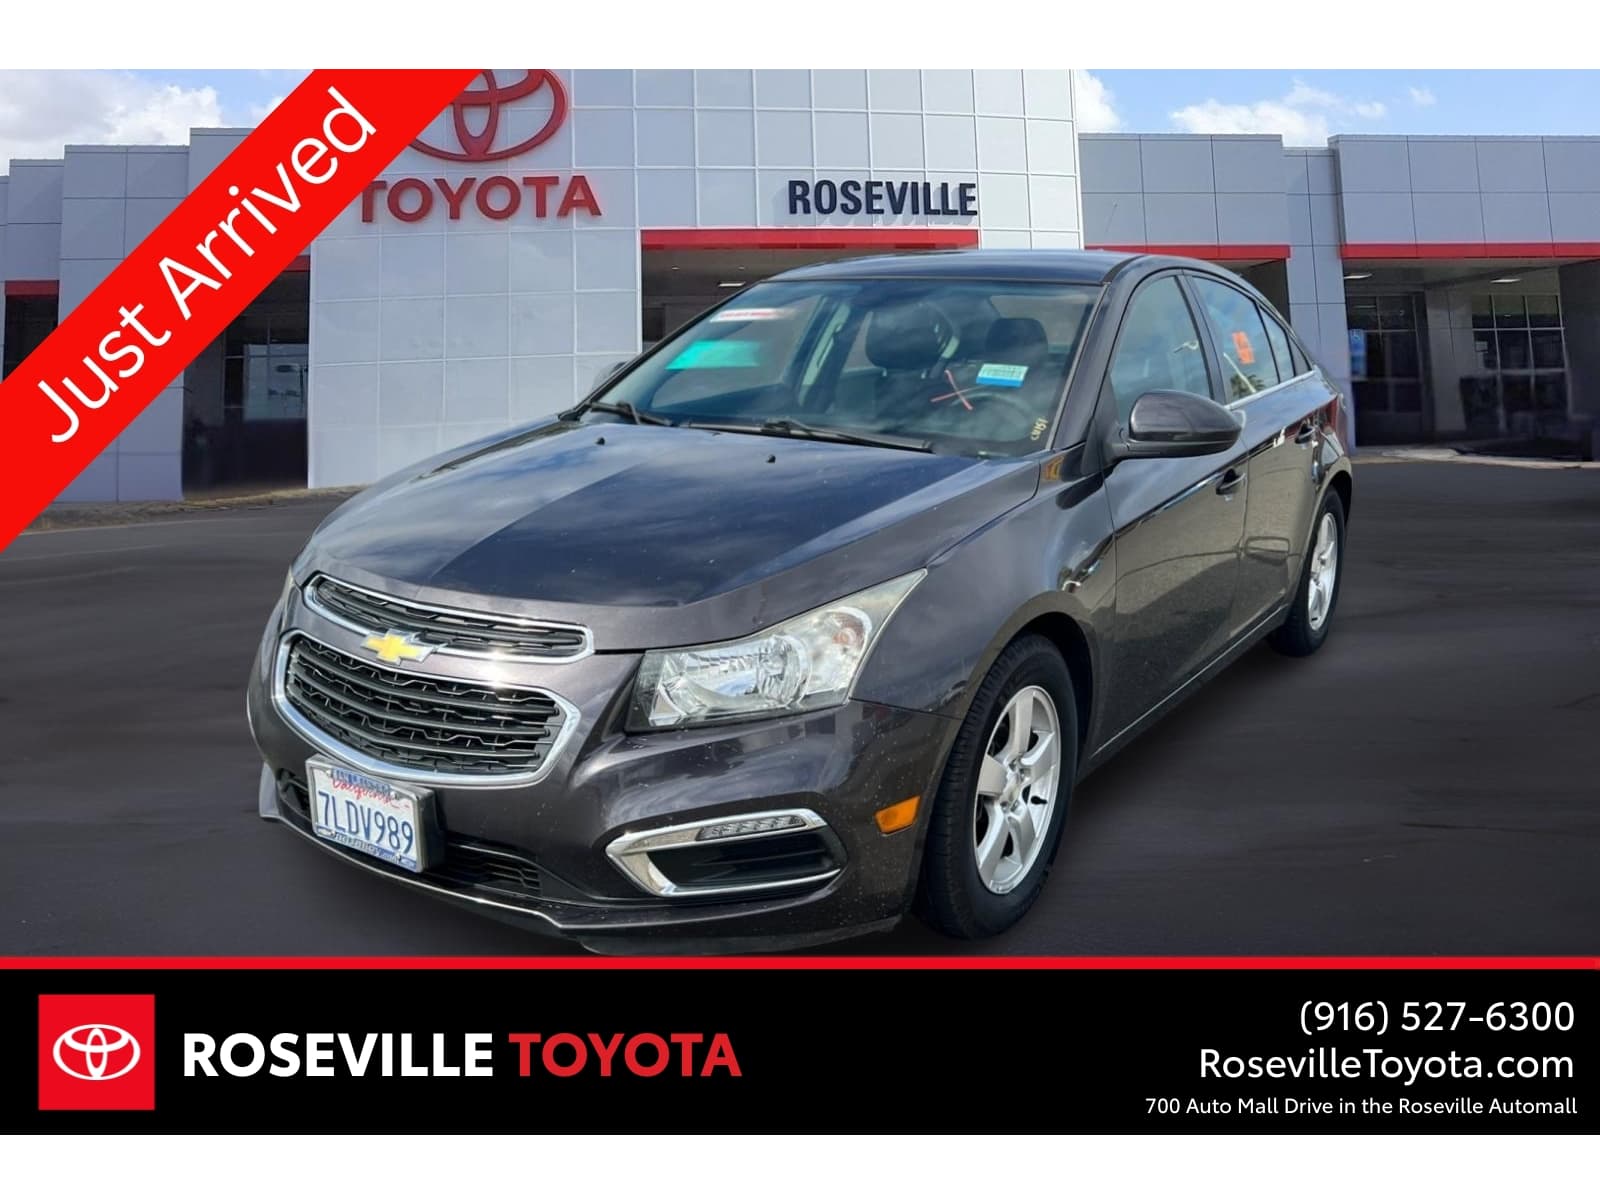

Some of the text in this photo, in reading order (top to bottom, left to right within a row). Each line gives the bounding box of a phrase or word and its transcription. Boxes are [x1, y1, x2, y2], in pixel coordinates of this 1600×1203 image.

[361, 175, 603, 223] TOYOTA
[787, 179, 979, 216] ROSEVILLE
[318, 790, 414, 855] 7LDV989
